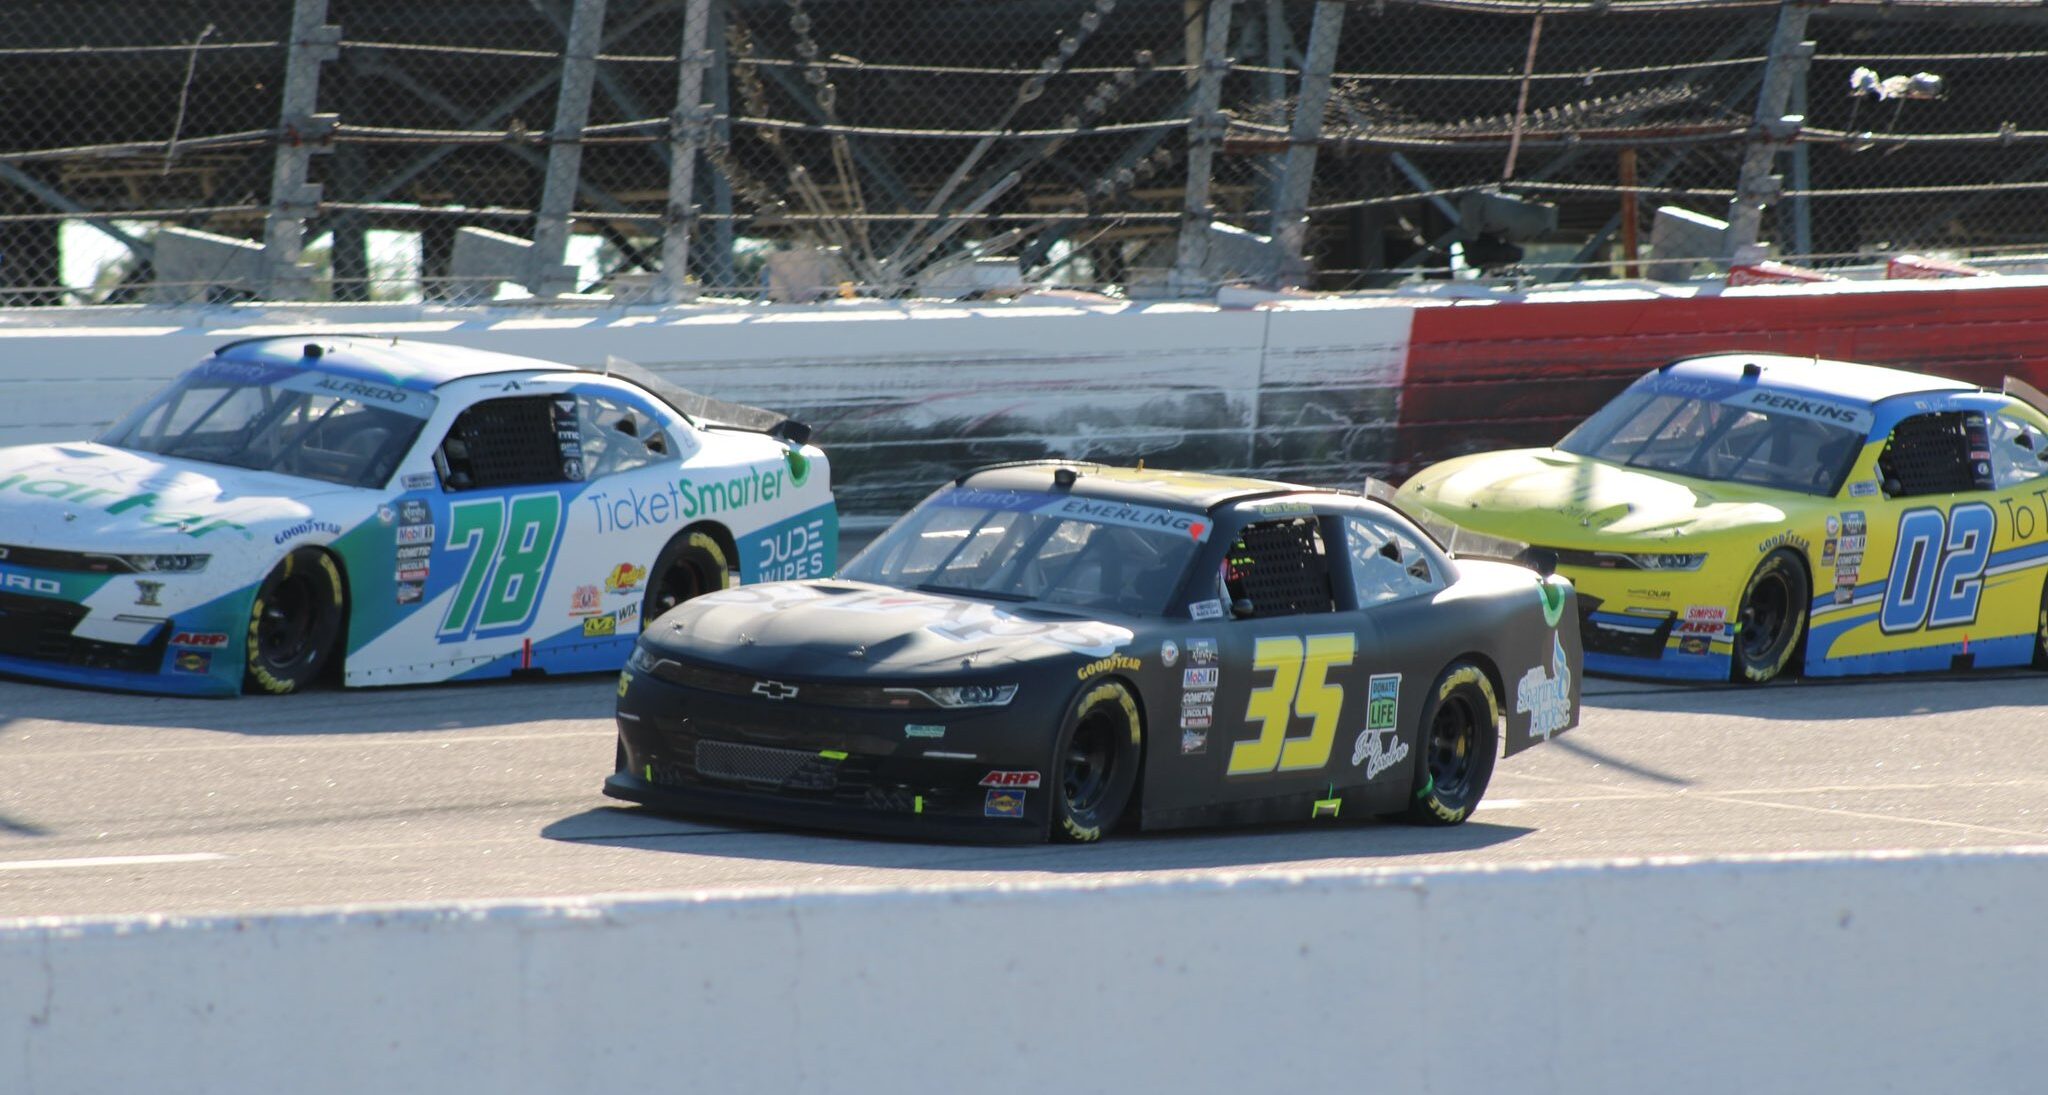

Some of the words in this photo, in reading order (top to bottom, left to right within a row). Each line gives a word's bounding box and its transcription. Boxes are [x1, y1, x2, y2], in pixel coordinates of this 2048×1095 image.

[316, 378, 407, 403] ALFREDO
[1751, 391, 1857, 423] PERKINS
[588, 466, 784, 534] TicketSmarter
[1062, 500, 1192, 531] EMERLING
[274, 518, 342, 546] GOODYEAR
[759, 519, 824, 567] DUDE
[437, 490, 563, 643] 78
[1879, 500, 1998, 637] 02
[618, 602, 638, 622] WIX
[1688, 608, 1725, 619] SIMPSON
[171, 632, 229, 646] ARP
[1680, 623, 1725, 633] ARP
[1077, 654, 1141, 681] GOODYEAR
[1185, 669, 1208, 685] Mobil
[1372, 681, 1396, 693] DONATE
[1227, 632, 1356, 777] 35
[1370, 703, 1394, 724] LIFE
[982, 771, 1041, 786] ARP
